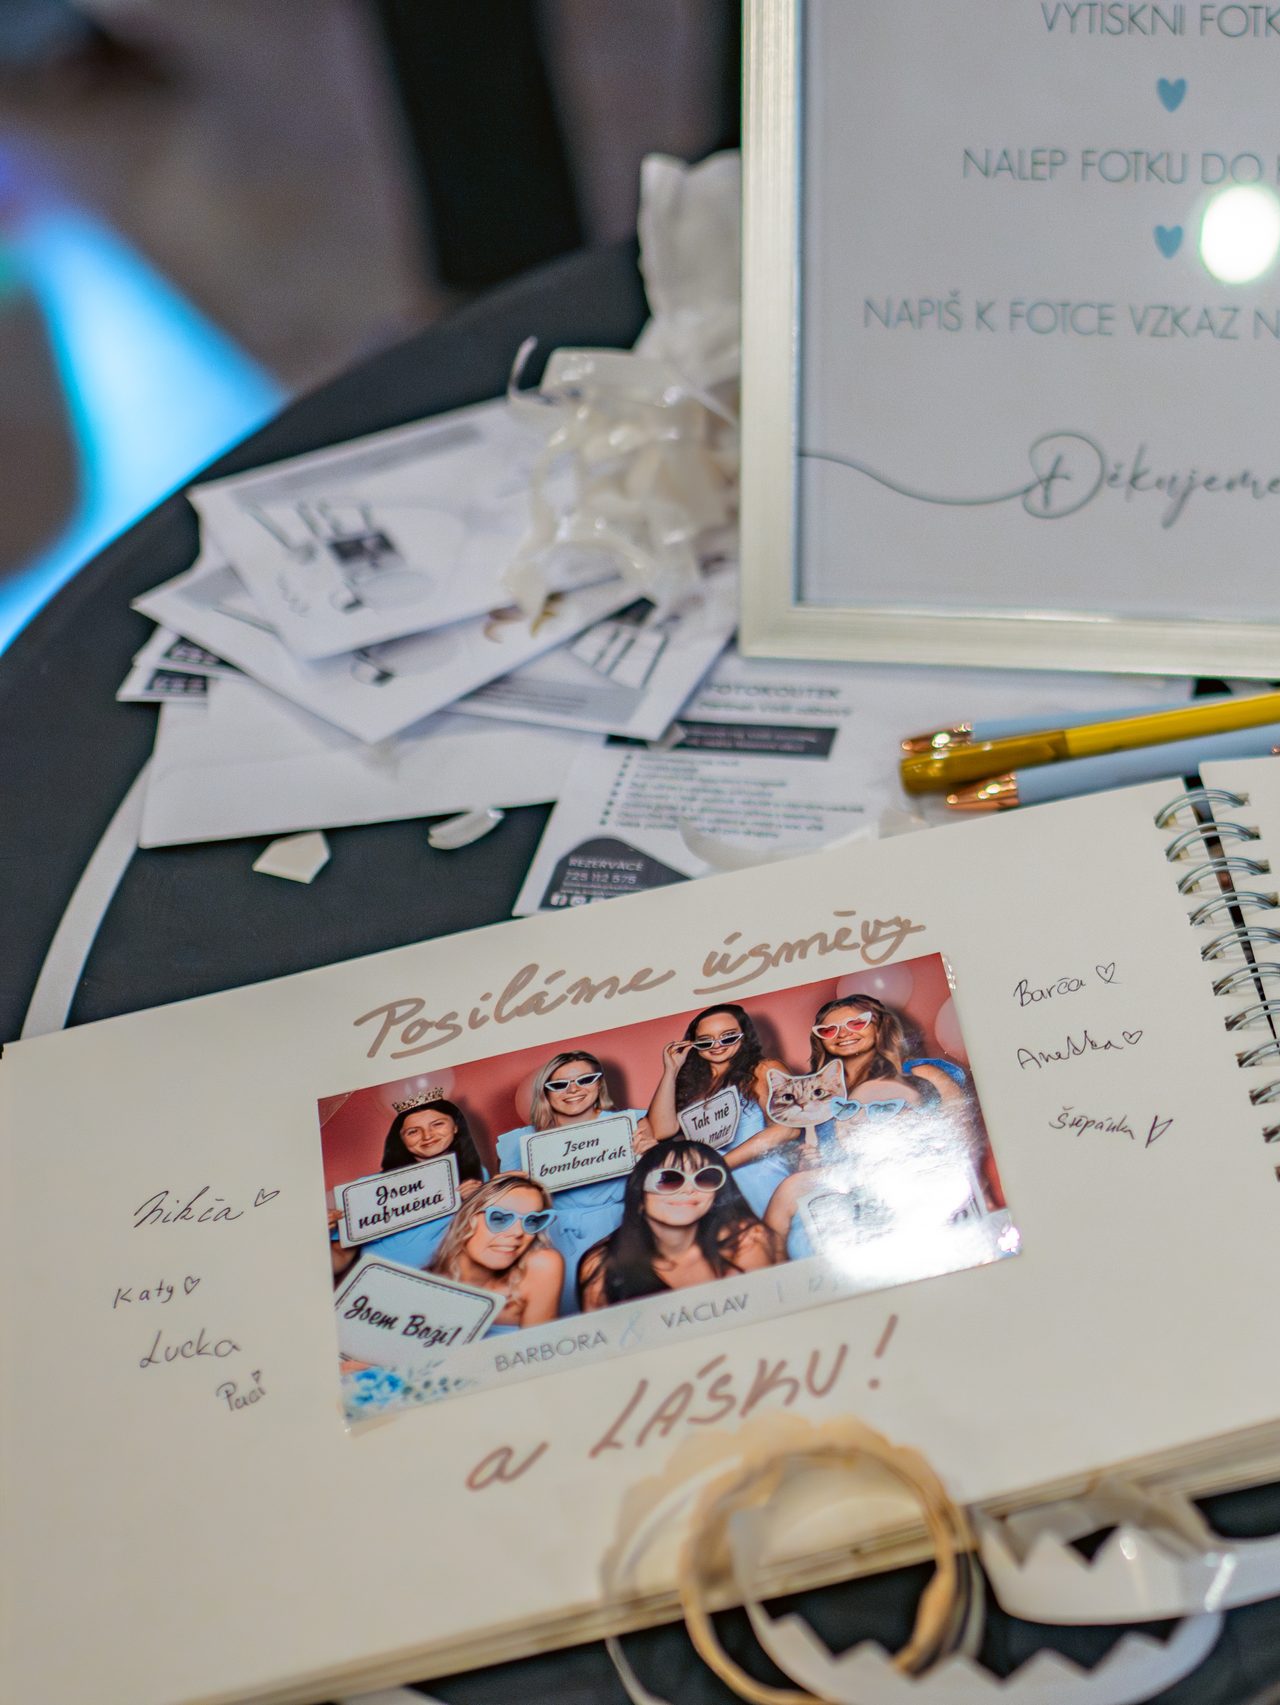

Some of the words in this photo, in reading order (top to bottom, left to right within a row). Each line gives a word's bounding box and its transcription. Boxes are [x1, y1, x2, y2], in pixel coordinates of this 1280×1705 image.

[1041, 2, 1185, 36] VYTISKNI
[962, 148, 1068, 182] NALEP
[1081, 150, 1187, 184] FOTKU
[1201, 152, 1264, 186] DO
[862, 290, 961, 332] NAPIŠ
[975, 301, 997, 332] K
[1008, 302, 1114, 336] FOTCE
[1129, 304, 1239, 340] VZKAZ
[691, 1111, 710, 1130] Tak
[539, 1146, 626, 1177] bombarďák
[563, 1138, 599, 1157] Jsem
[376, 1180, 424, 1206] Jsem
[113, 1280, 174, 1309] Katy
[344, 1296, 399, 1330] Jsem
[139, 1328, 241, 1368] Lucka
[494, 1329, 607, 1372] BARBORA
[660, 1293, 749, 1328] VÁCLAV
[465, 1441, 549, 1491] a
